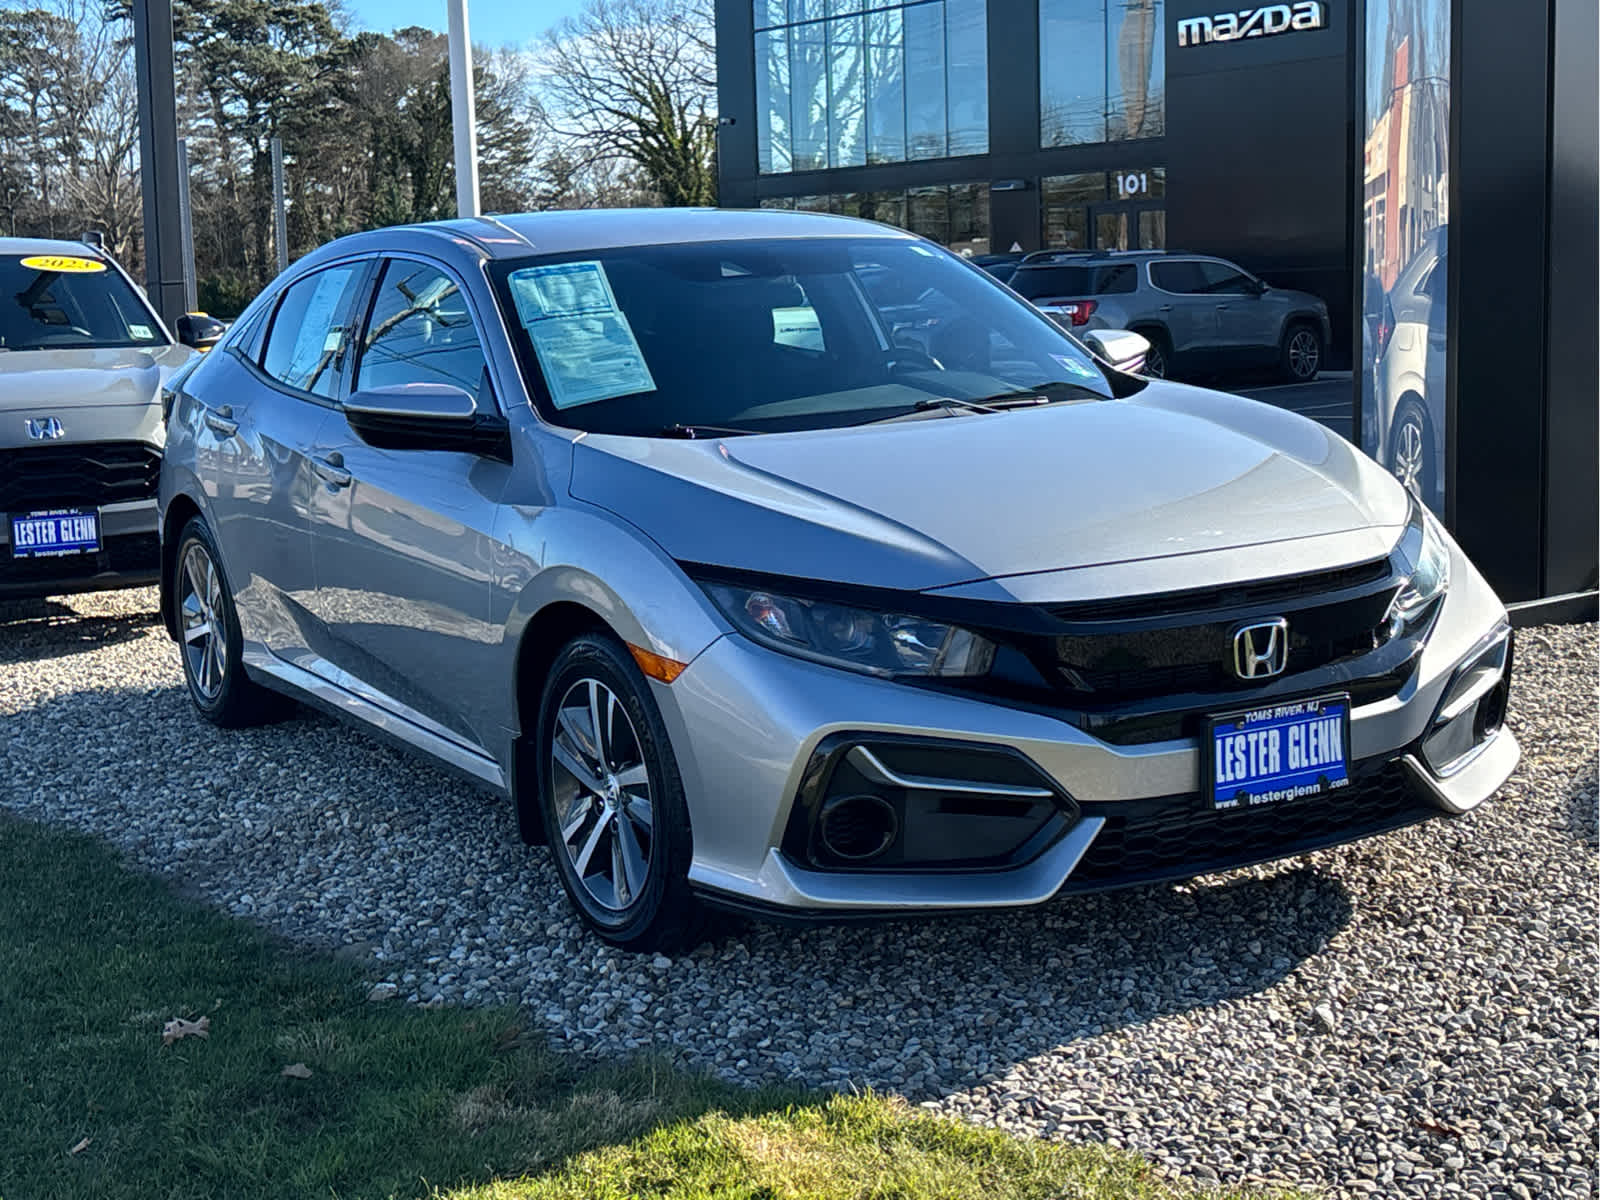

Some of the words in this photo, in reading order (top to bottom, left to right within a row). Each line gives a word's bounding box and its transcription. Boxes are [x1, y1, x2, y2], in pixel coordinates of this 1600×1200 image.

[1117, 173, 1147, 194] 101
[14, 521, 57, 546] LESTER
[60, 517, 97, 542] GLENN
[1245, 710, 1273, 724] TOMS
[1274, 704, 1305, 718] RIVER,
[1306, 701, 1320, 713] NJ
[1215, 729, 1281, 783] LESTER
[1288, 718, 1343, 770] GLENN
[1249, 784, 1321, 805] lesterglenn
